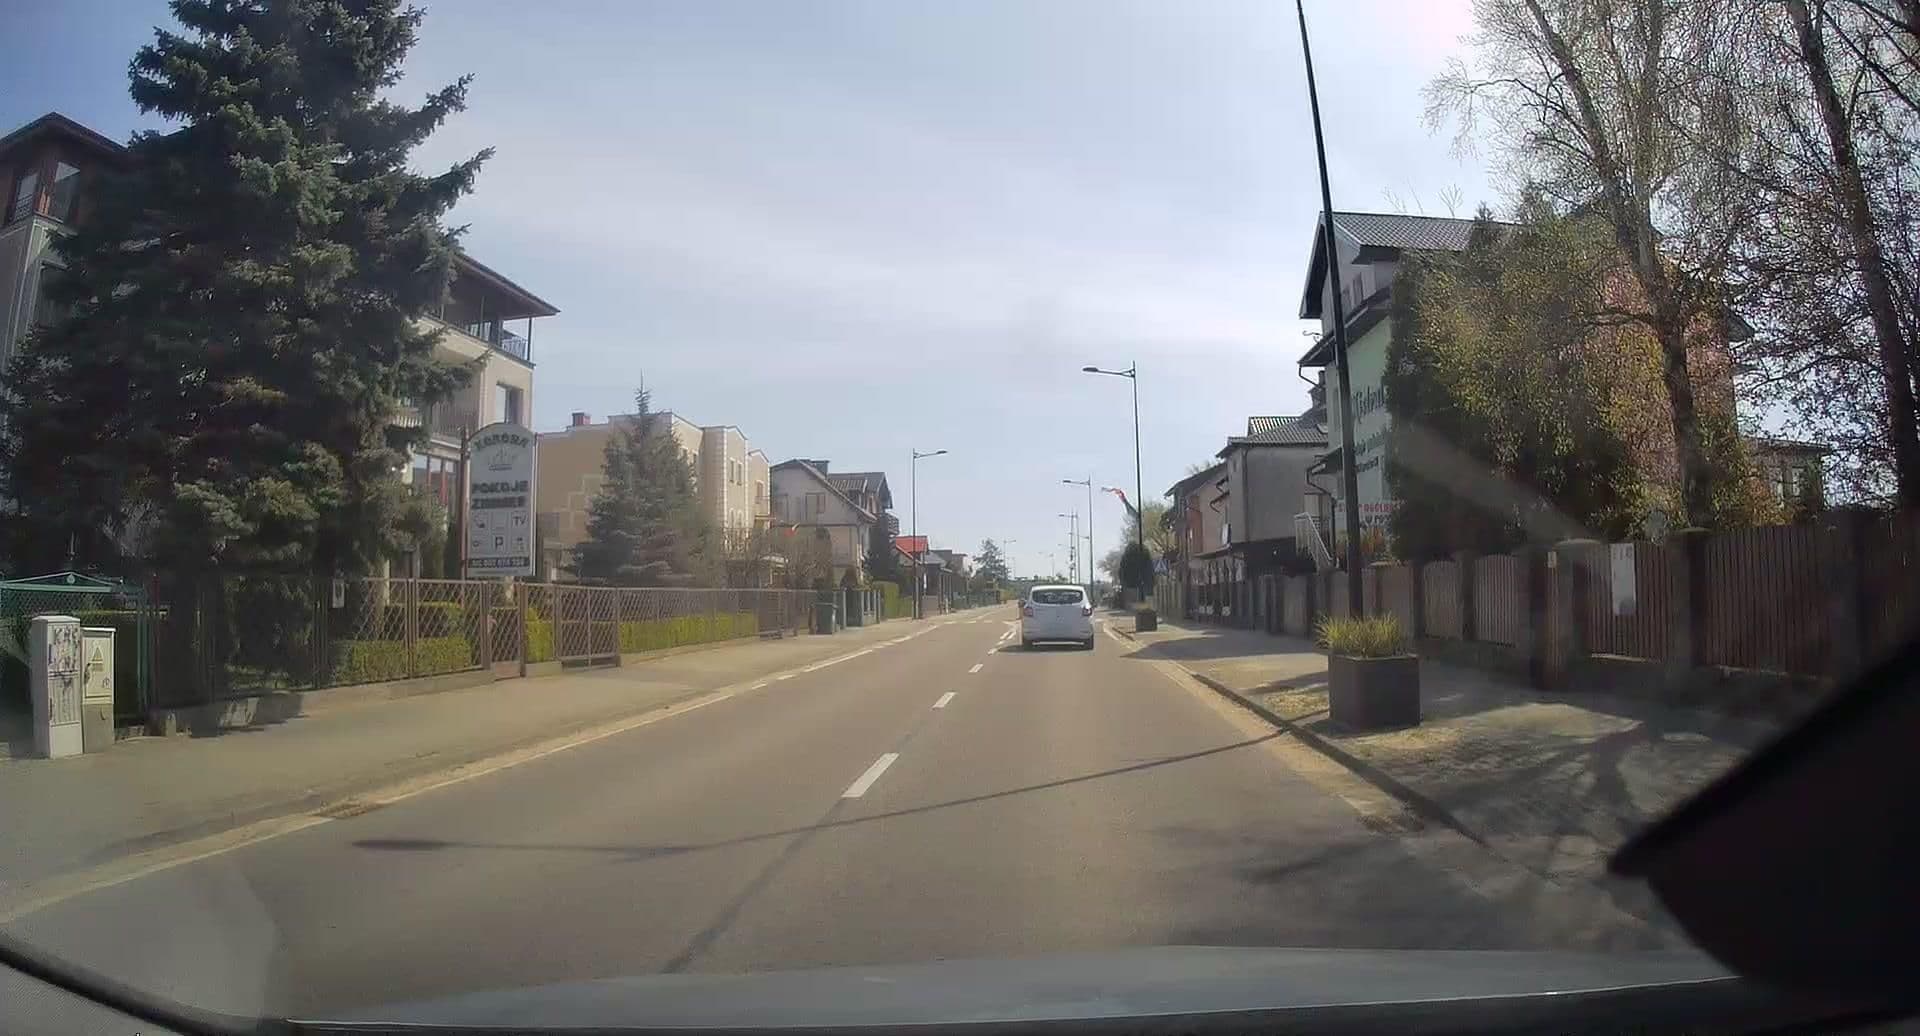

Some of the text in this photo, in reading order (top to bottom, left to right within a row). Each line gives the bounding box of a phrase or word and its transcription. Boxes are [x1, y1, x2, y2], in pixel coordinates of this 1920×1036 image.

[472, 480, 529, 494] POKOJE
[513, 514, 526, 527] TV
[495, 536, 504, 550] P
